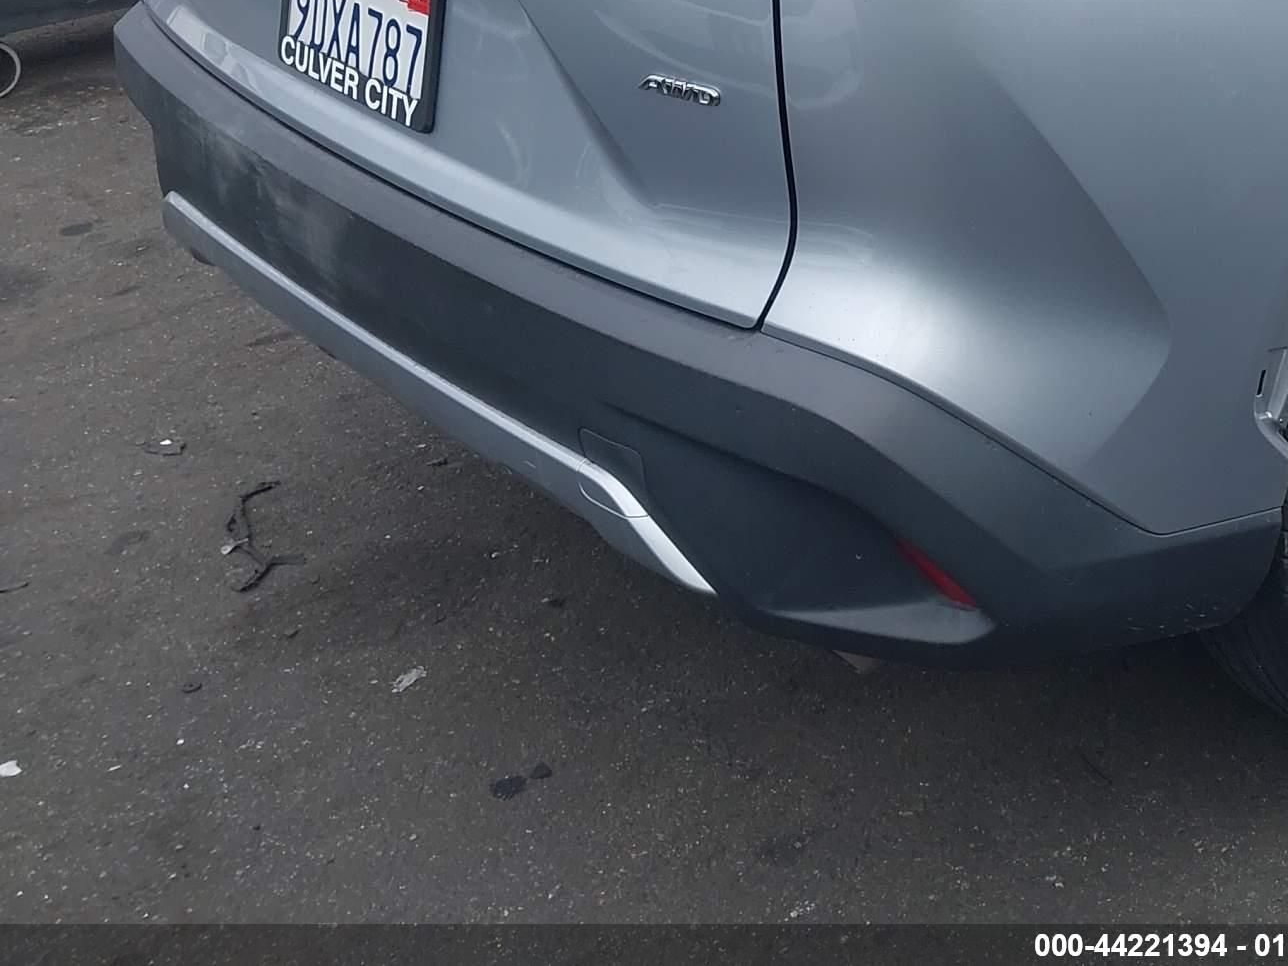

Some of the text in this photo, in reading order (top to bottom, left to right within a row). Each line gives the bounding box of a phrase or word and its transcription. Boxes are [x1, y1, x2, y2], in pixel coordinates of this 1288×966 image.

[281, 35, 418, 127] CULVER CITY
[639, 74, 721, 107] AWD
